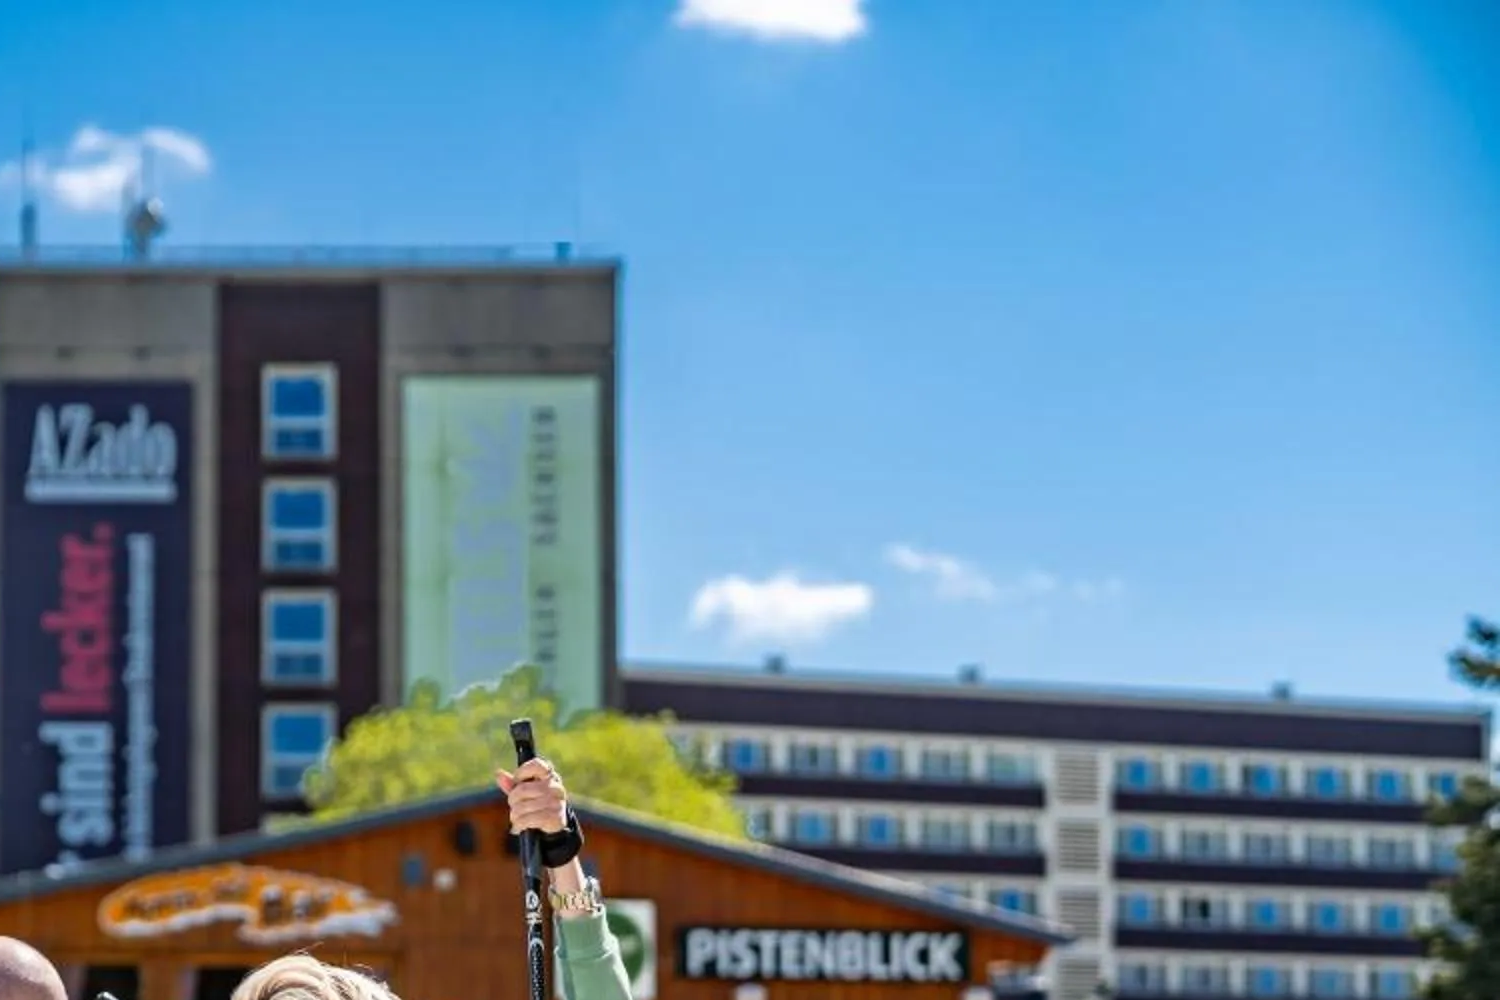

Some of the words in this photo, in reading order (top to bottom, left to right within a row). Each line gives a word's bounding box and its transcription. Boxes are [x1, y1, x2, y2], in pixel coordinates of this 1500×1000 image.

[39, 521, 114, 713] lecker.
[38, 720, 114, 846] sind
[686, 927, 964, 982] PISTENBLICK
